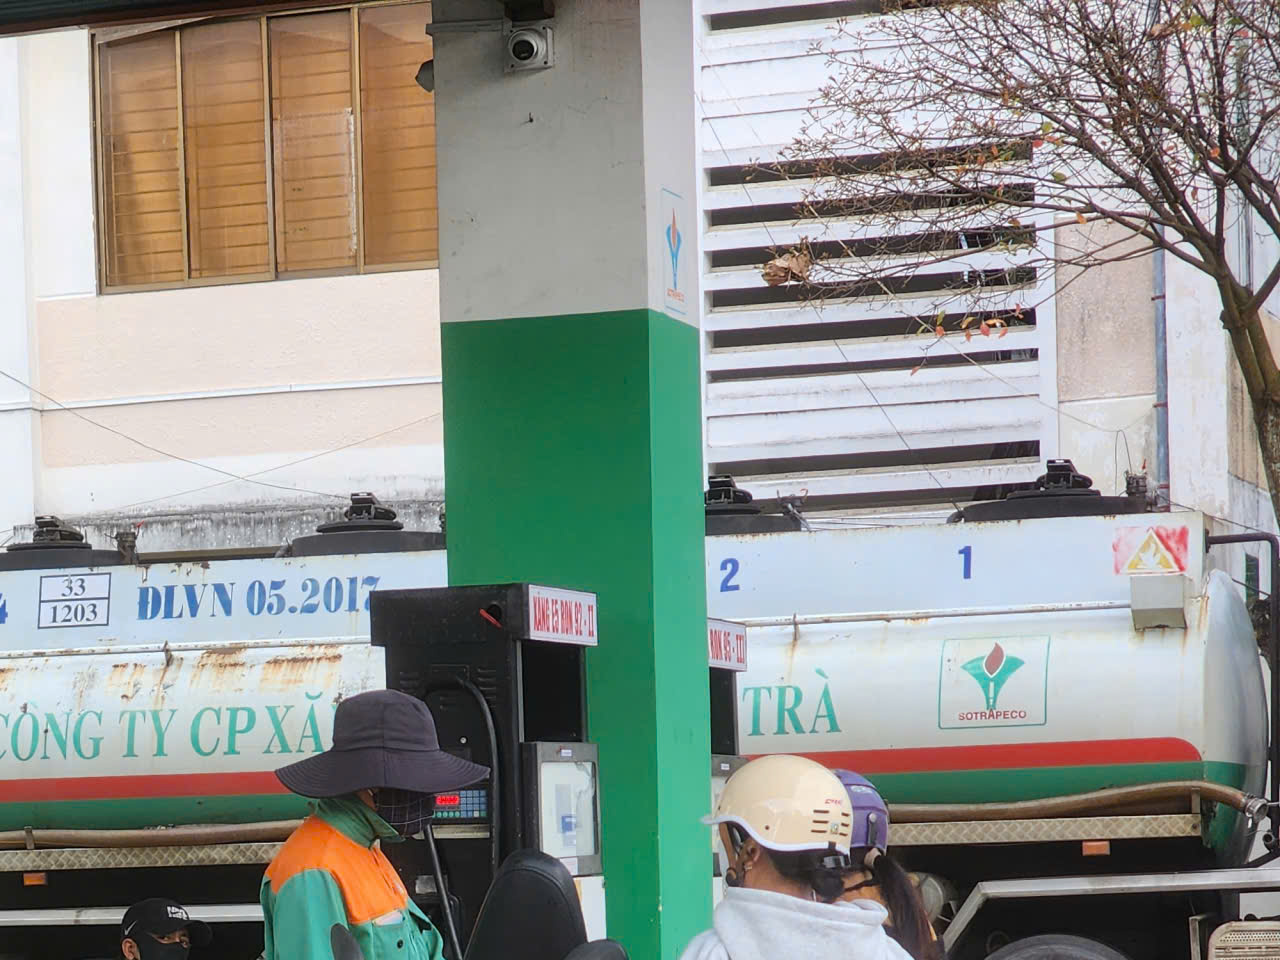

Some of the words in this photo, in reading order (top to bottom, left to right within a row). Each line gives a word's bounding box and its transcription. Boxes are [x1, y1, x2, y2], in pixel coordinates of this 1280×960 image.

[719, 557, 740, 592] 2
[957, 545, 972, 579] 1
[61, 578, 86, 597] 33
[246, 575, 381, 616] 05.2017
[49, 603, 98, 623] 1203
[533, 591, 550, 632] XĂNG
[551, 599, 559, 634] E5
[560, 599, 573, 635] RON
[574, 601, 583, 636] 92
[741, 666, 842, 737] TRÀ
[957, 708, 1027, 721] SOTRAPECO
[119, 708, 178, 758] TY
[190, 705, 257, 757] CP
[262, 691, 336, 754] XĂ
